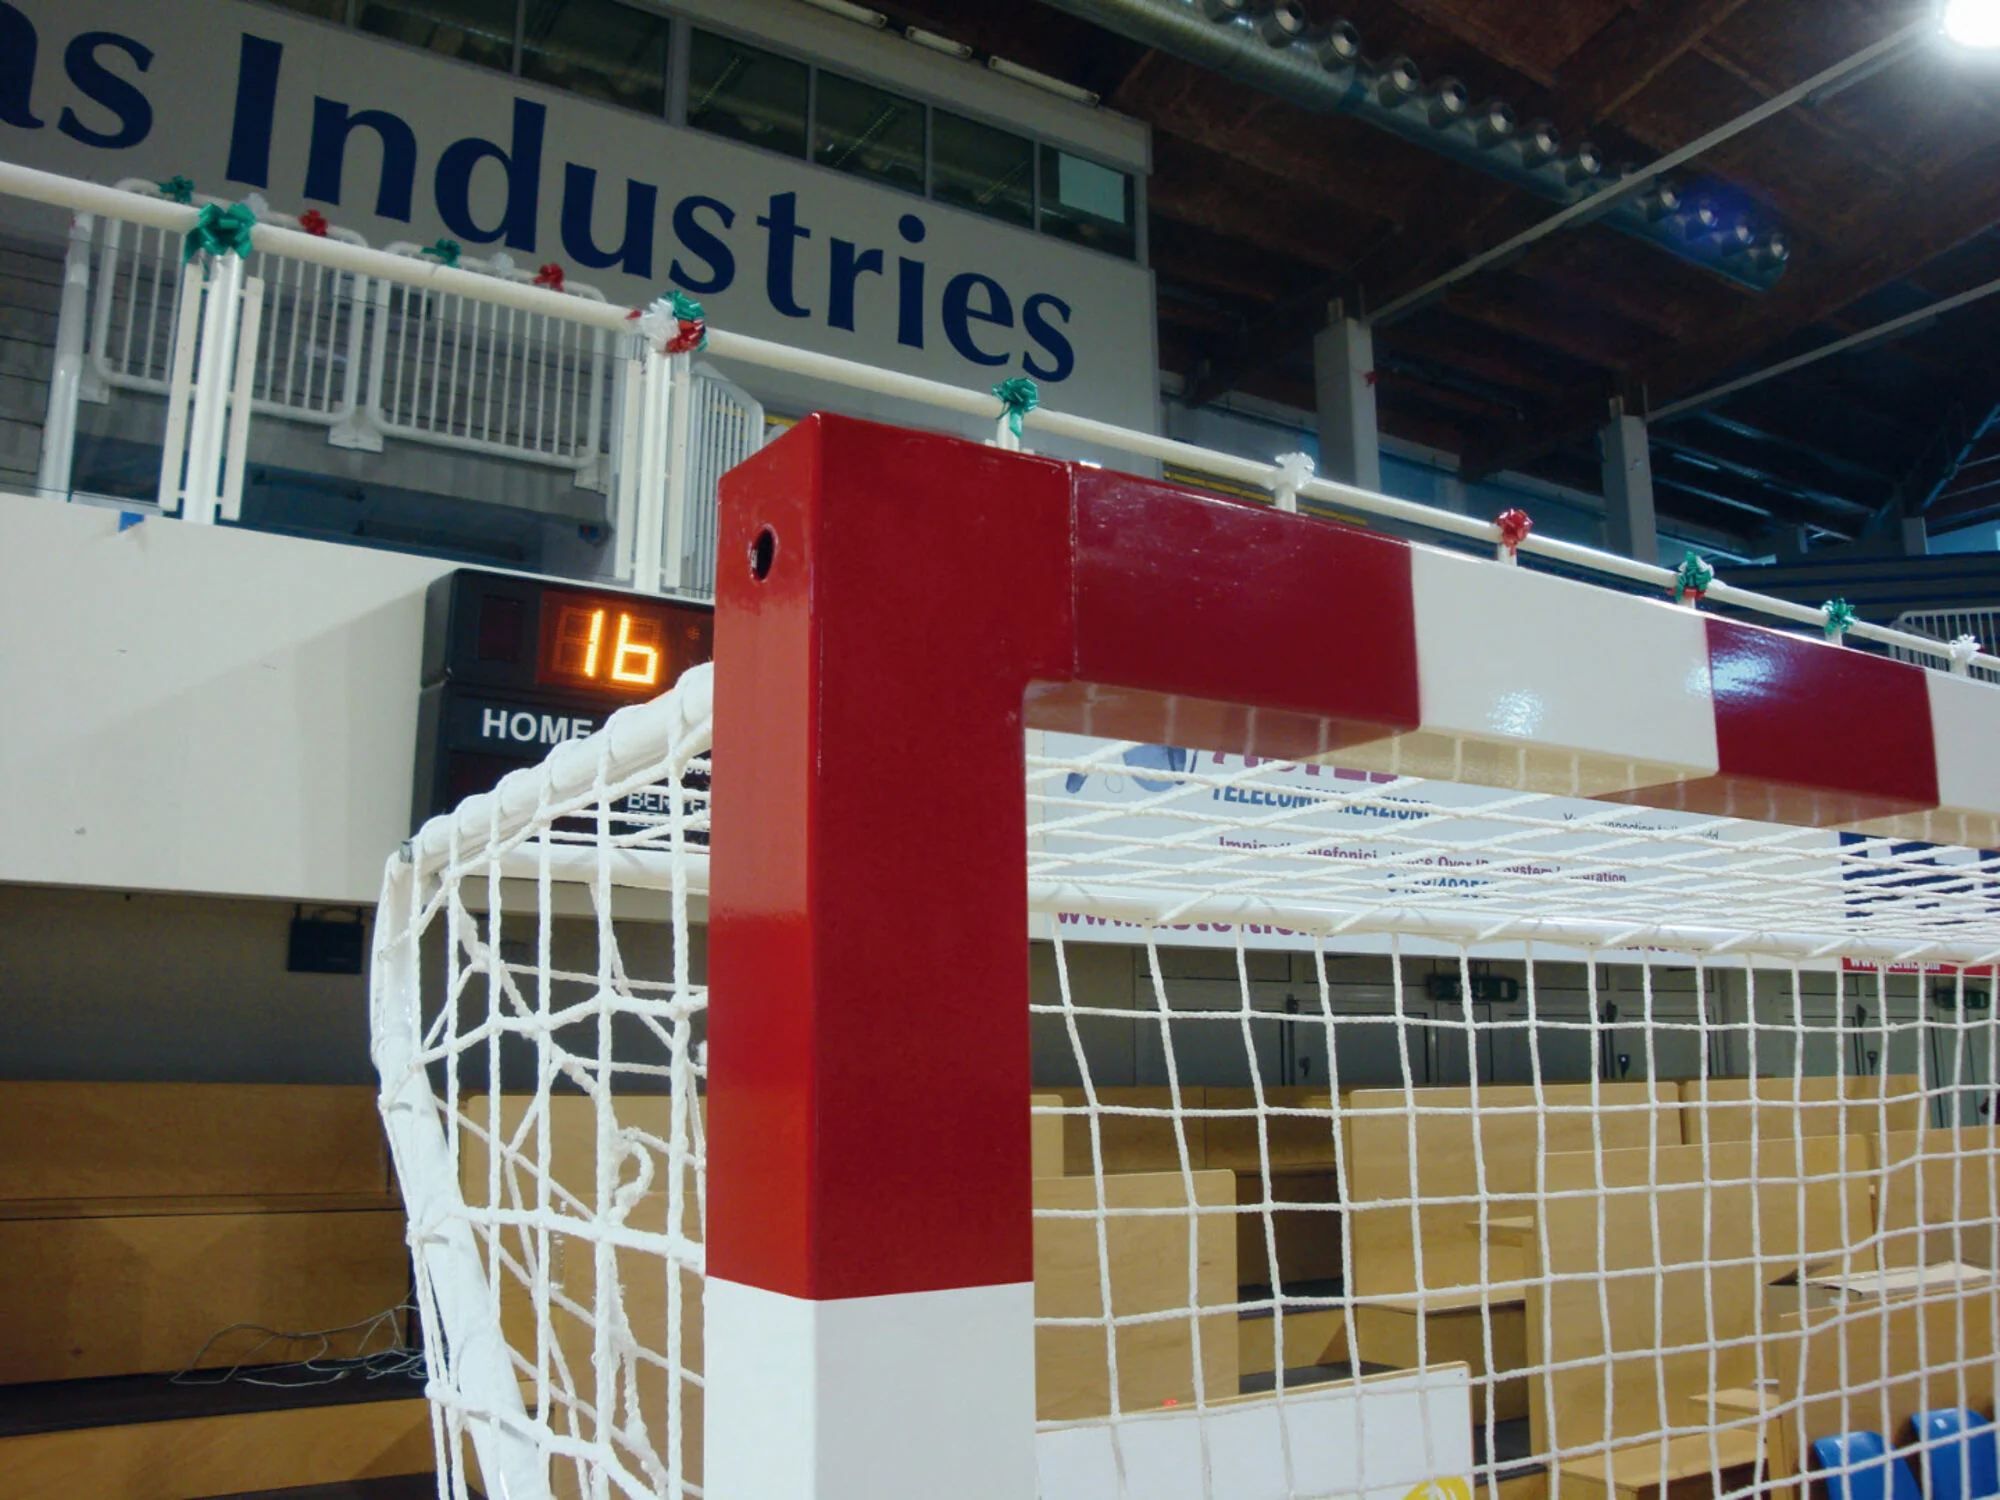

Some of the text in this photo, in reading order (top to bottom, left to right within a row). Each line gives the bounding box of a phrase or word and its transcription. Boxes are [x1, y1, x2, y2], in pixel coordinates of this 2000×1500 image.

[226, 33, 1075, 382] Industries
[584, 609, 659, 685] 16
[482, 707, 593, 744] HOME
